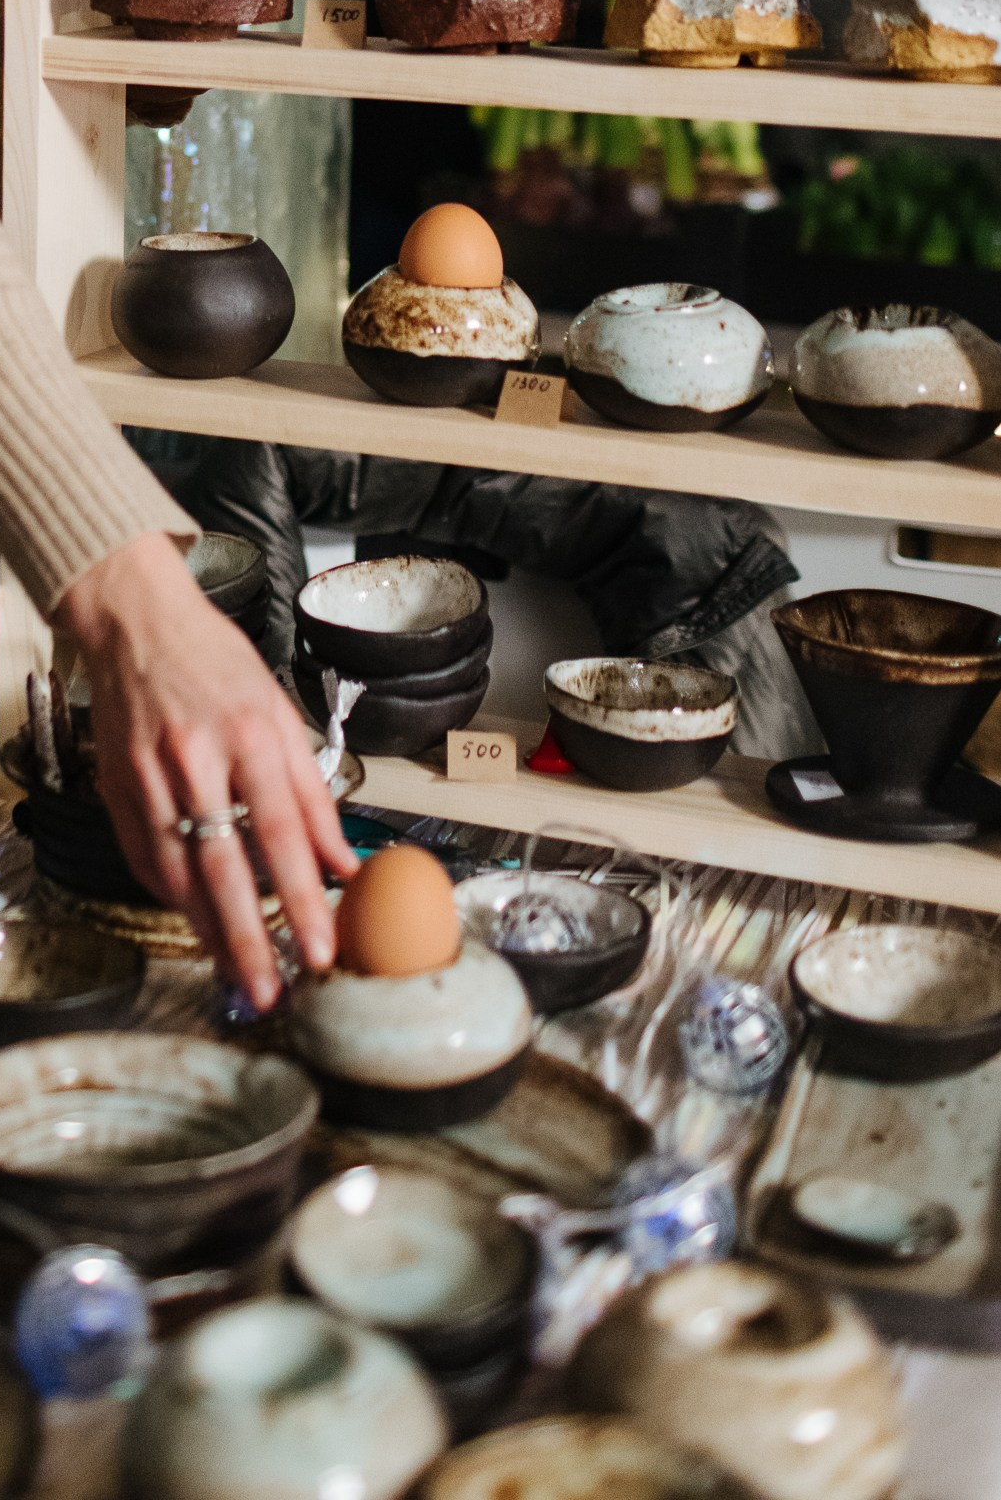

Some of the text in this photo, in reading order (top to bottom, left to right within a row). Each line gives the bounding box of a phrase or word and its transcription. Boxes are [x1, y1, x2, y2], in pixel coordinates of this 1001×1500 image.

[322, 7, 360, 23] 1500
[511, 376, 551, 392] 1300
[462, 740, 502, 759] 500
